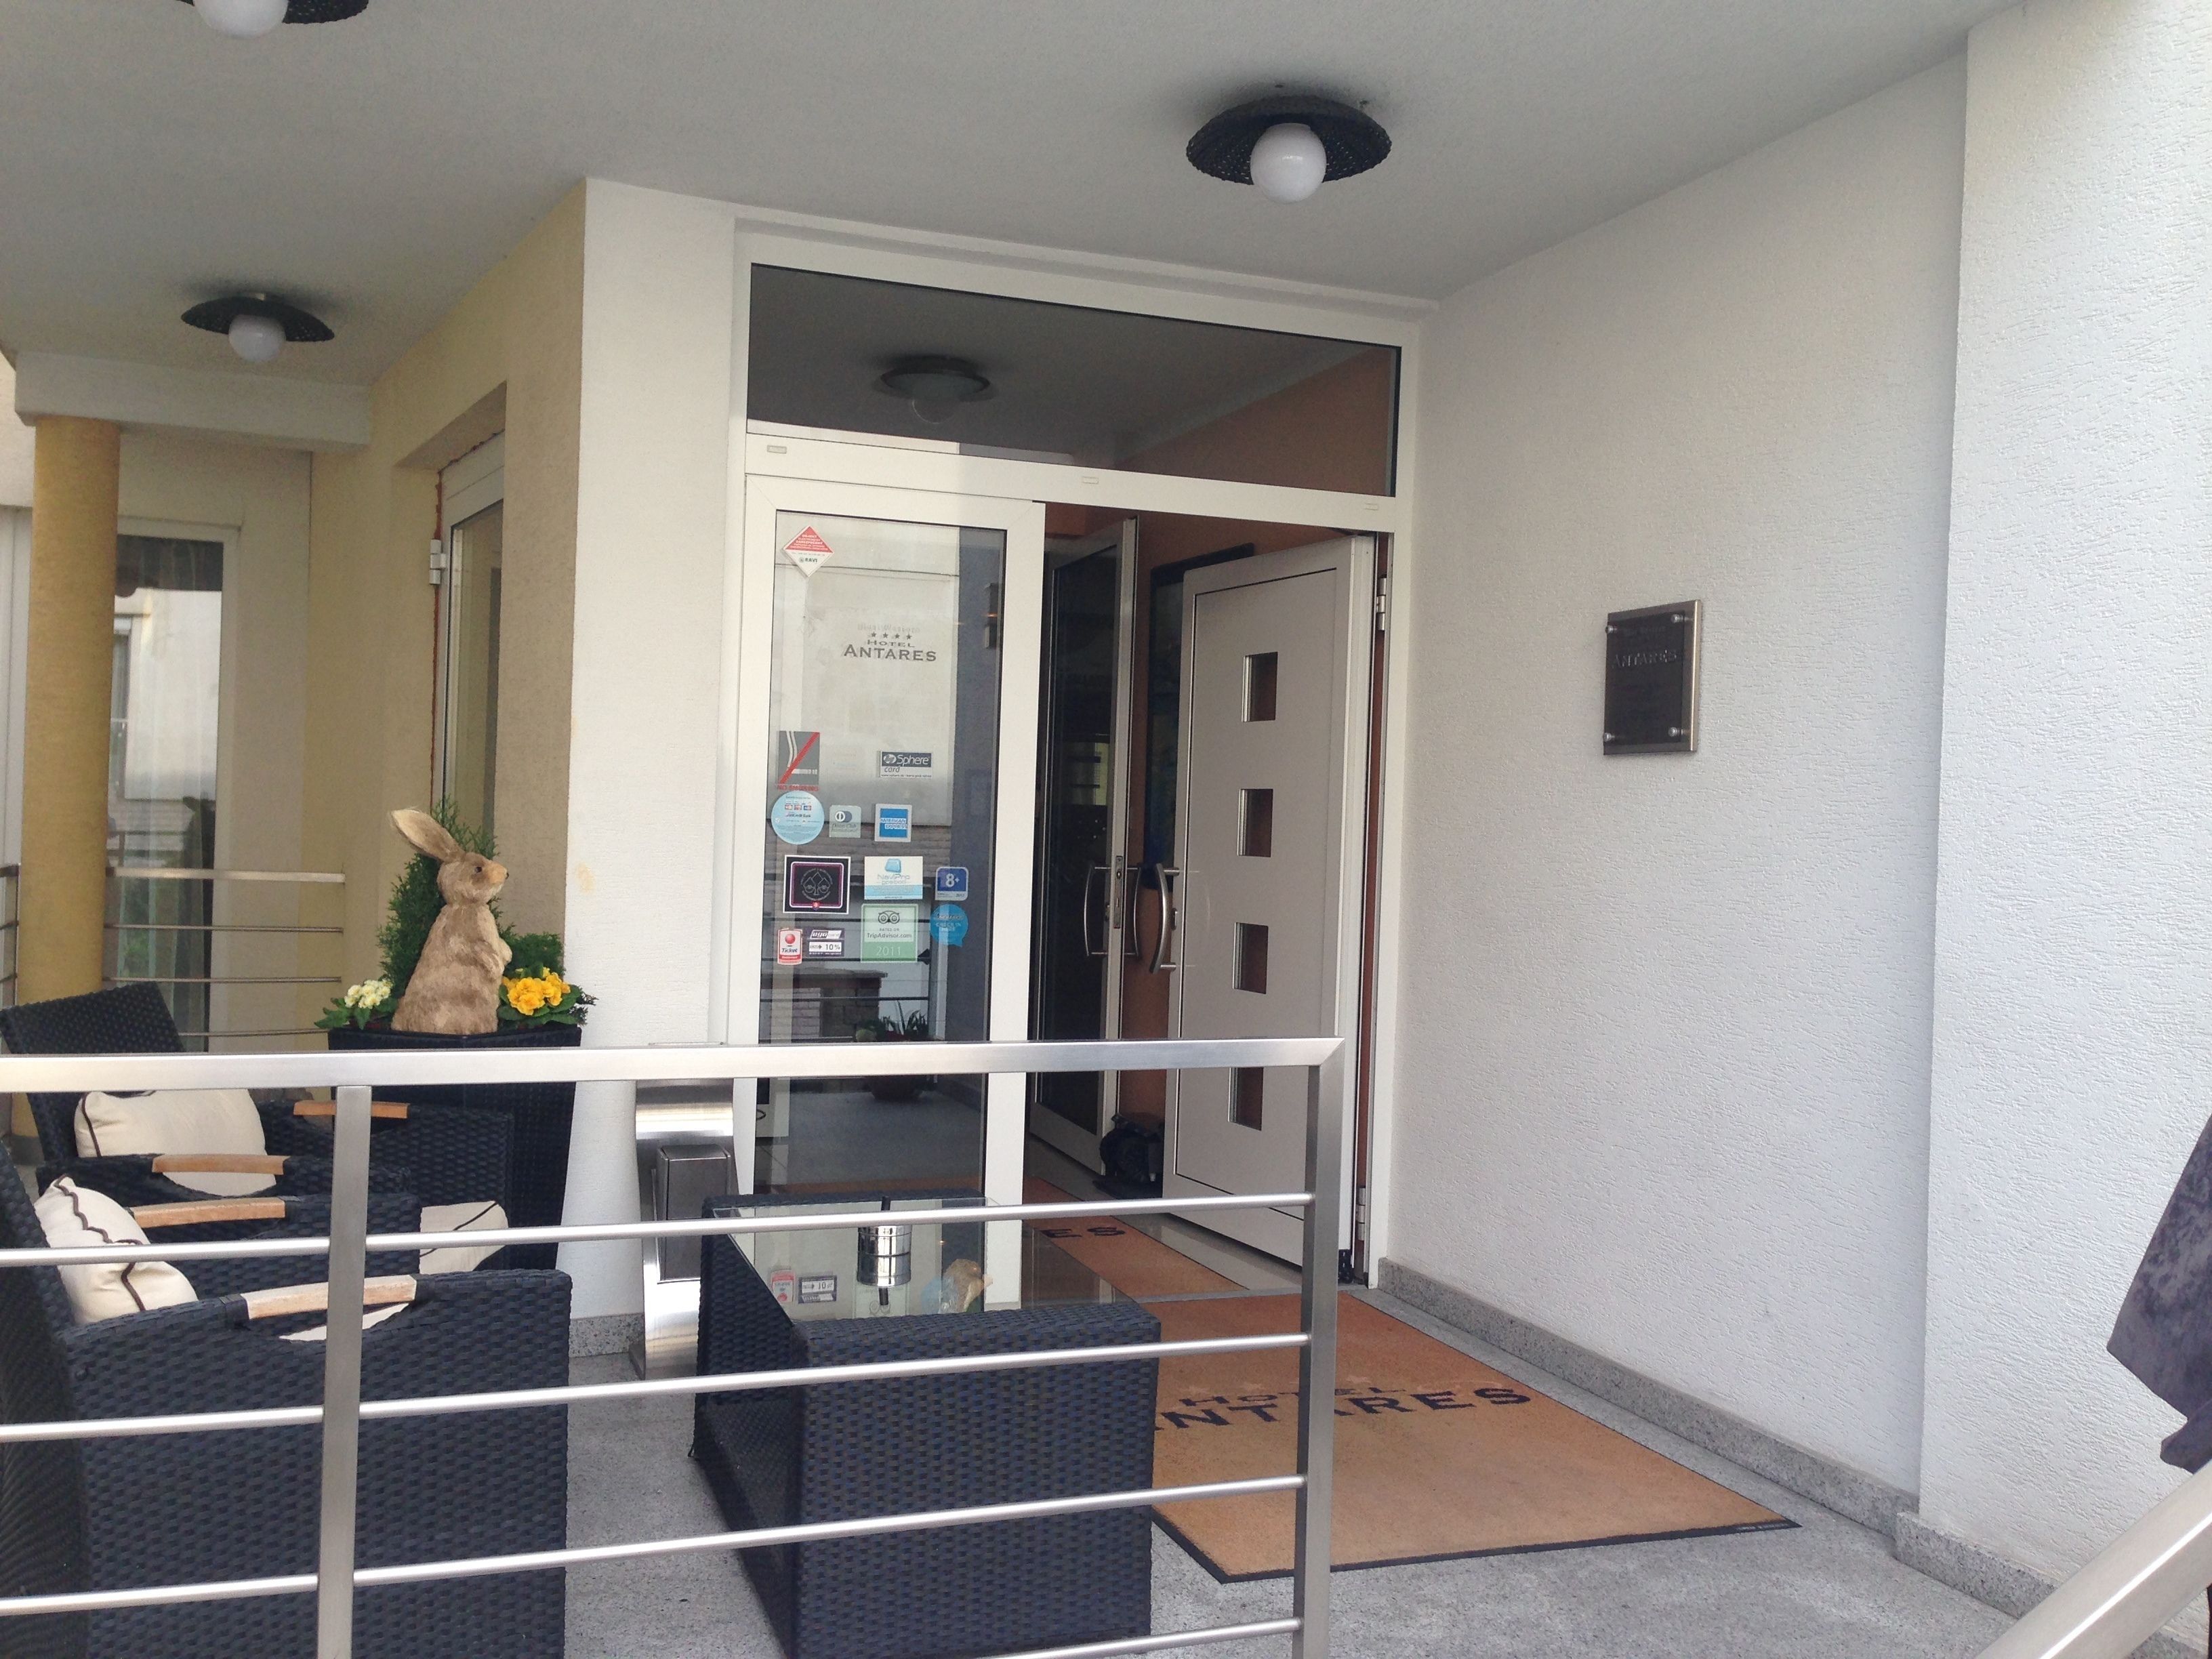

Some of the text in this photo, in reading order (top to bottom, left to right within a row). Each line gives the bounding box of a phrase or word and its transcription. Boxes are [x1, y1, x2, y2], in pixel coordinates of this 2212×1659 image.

[867, 639, 916, 648] HOTEL
[844, 644, 937, 661] ANTARES
[897, 754, 929, 766] Sphere
[877, 946, 901, 956] 2011
[1155, 1388, 1531, 1431] NTRES
